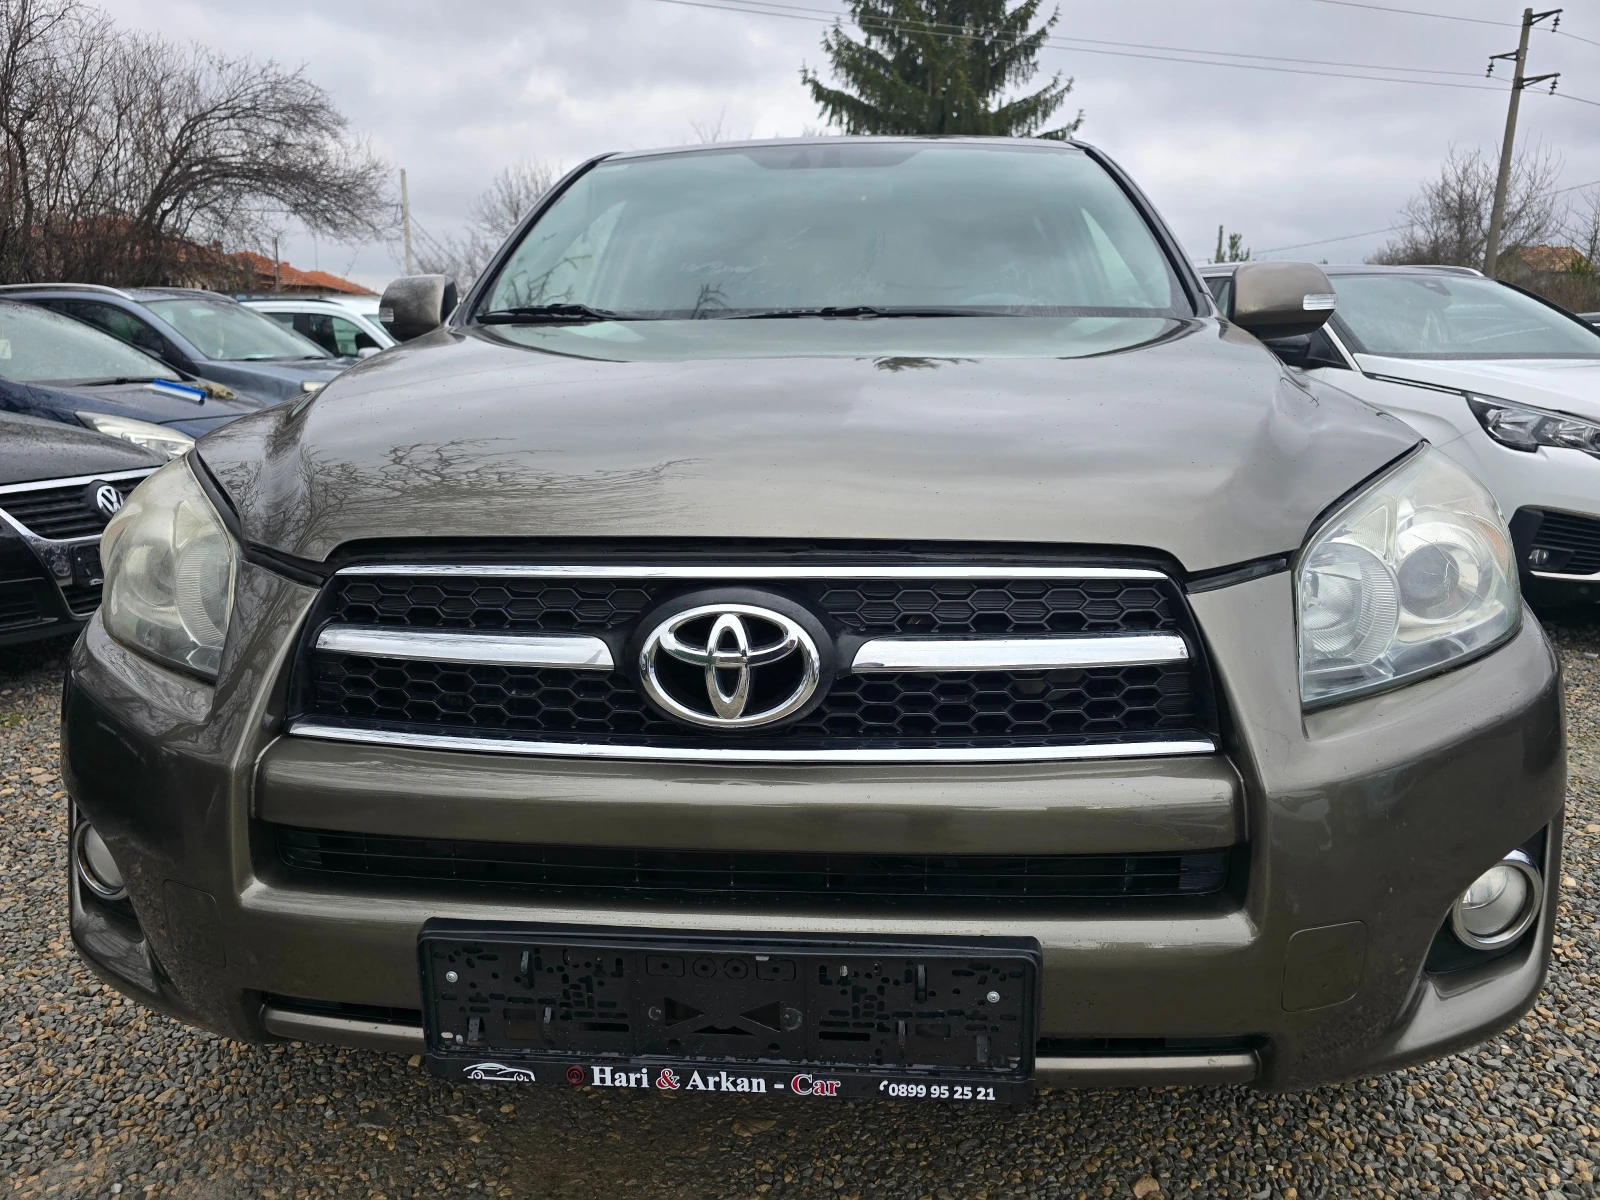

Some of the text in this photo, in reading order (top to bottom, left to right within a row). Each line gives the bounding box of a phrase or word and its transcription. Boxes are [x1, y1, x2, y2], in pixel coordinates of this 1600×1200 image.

[591, 1066, 650, 1088] Hari
[655, 1068, 680, 1090] &
[685, 1070, 767, 1093] Arkan
[790, 1073, 842, 1096] Car
[888, 1083, 996, 1101] 0899 95 25 21
